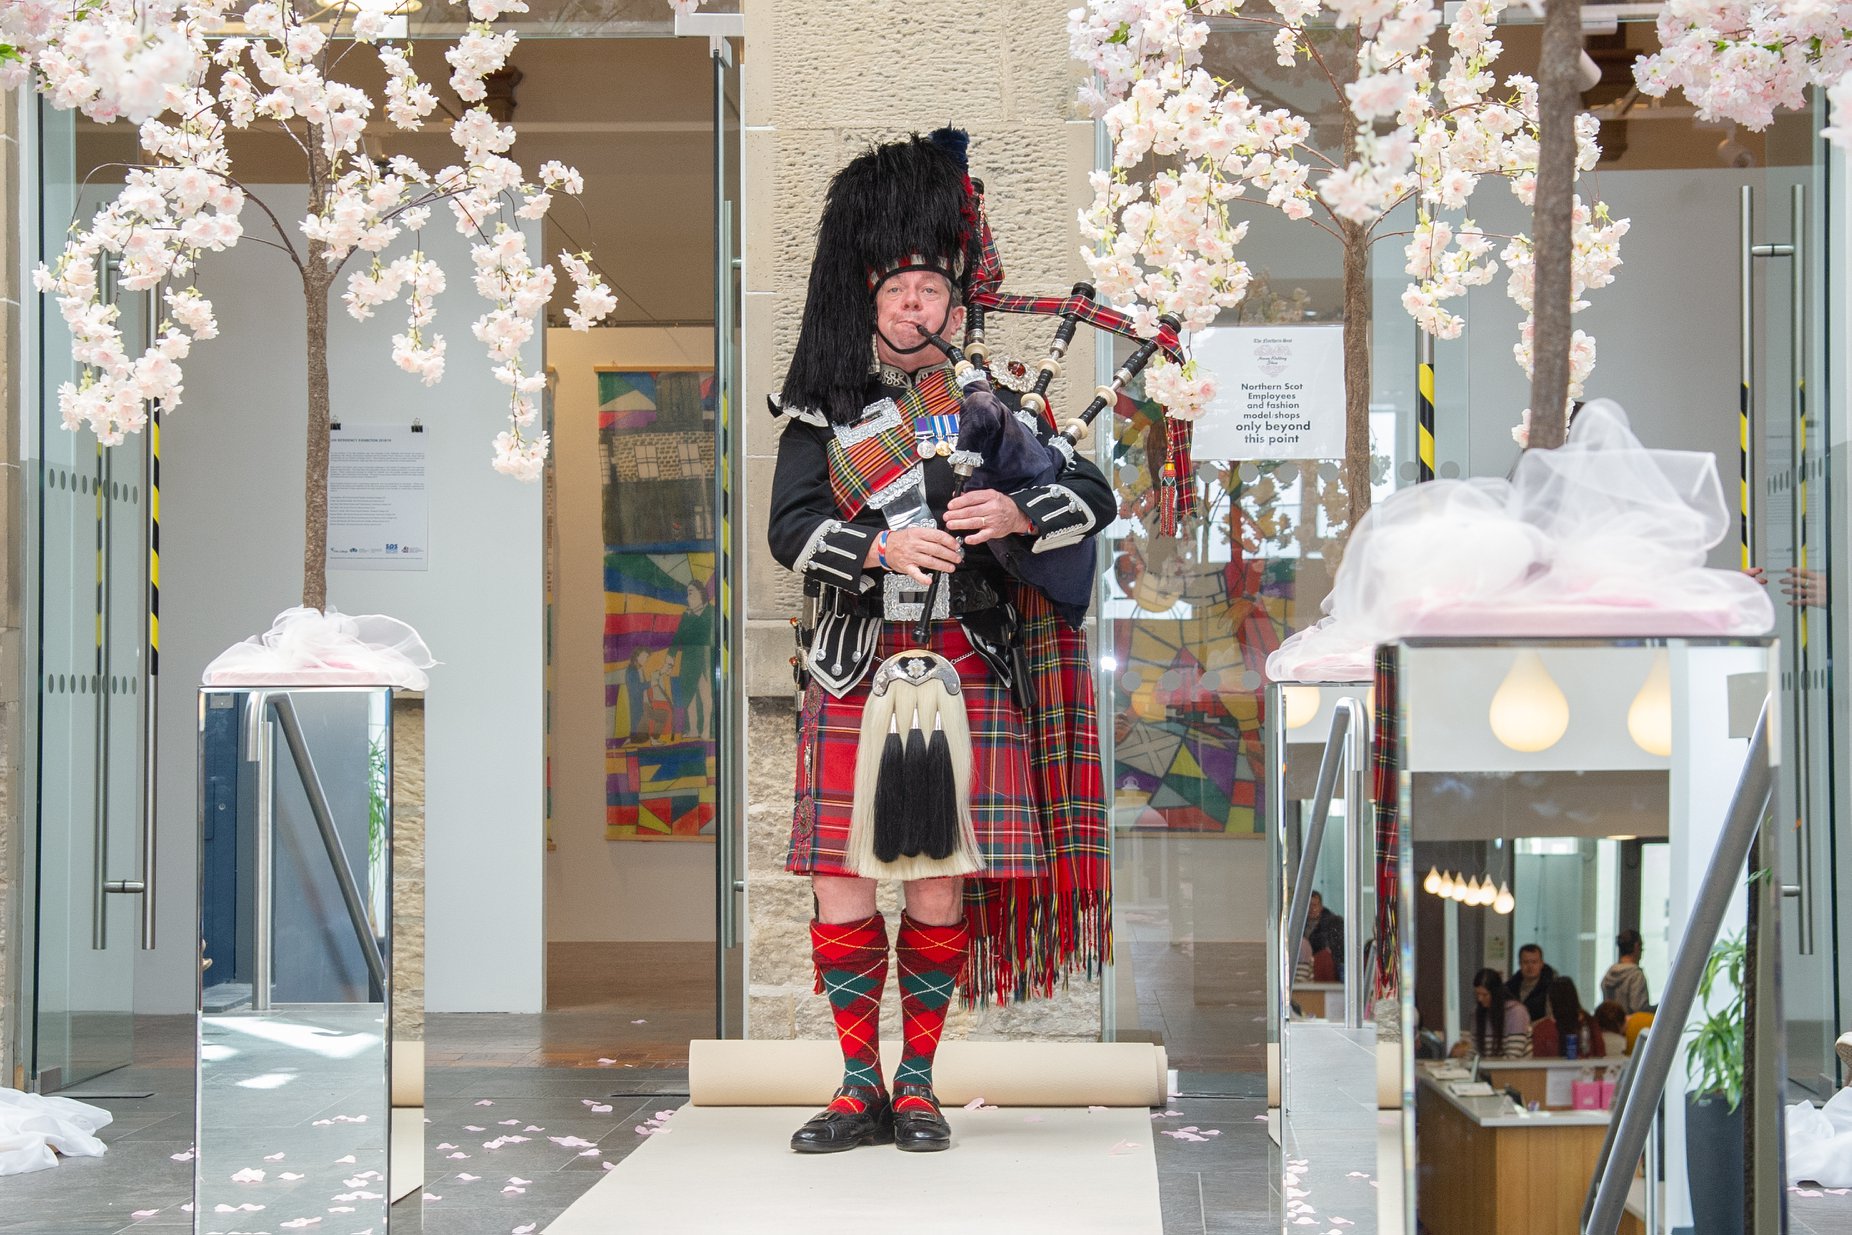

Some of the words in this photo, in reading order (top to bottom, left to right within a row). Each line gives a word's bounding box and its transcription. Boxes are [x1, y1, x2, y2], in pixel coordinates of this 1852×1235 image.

[1241, 382, 1282, 390] Northern
[1248, 392, 1296, 401] Employees
[1247, 401, 1264, 409] and
[1267, 401, 1300, 409] fashion
[1236, 421, 1261, 433] only
[1265, 421, 1311, 433] beyond
[1245, 434, 1265, 443] this
[1269, 433, 1299, 445] point
